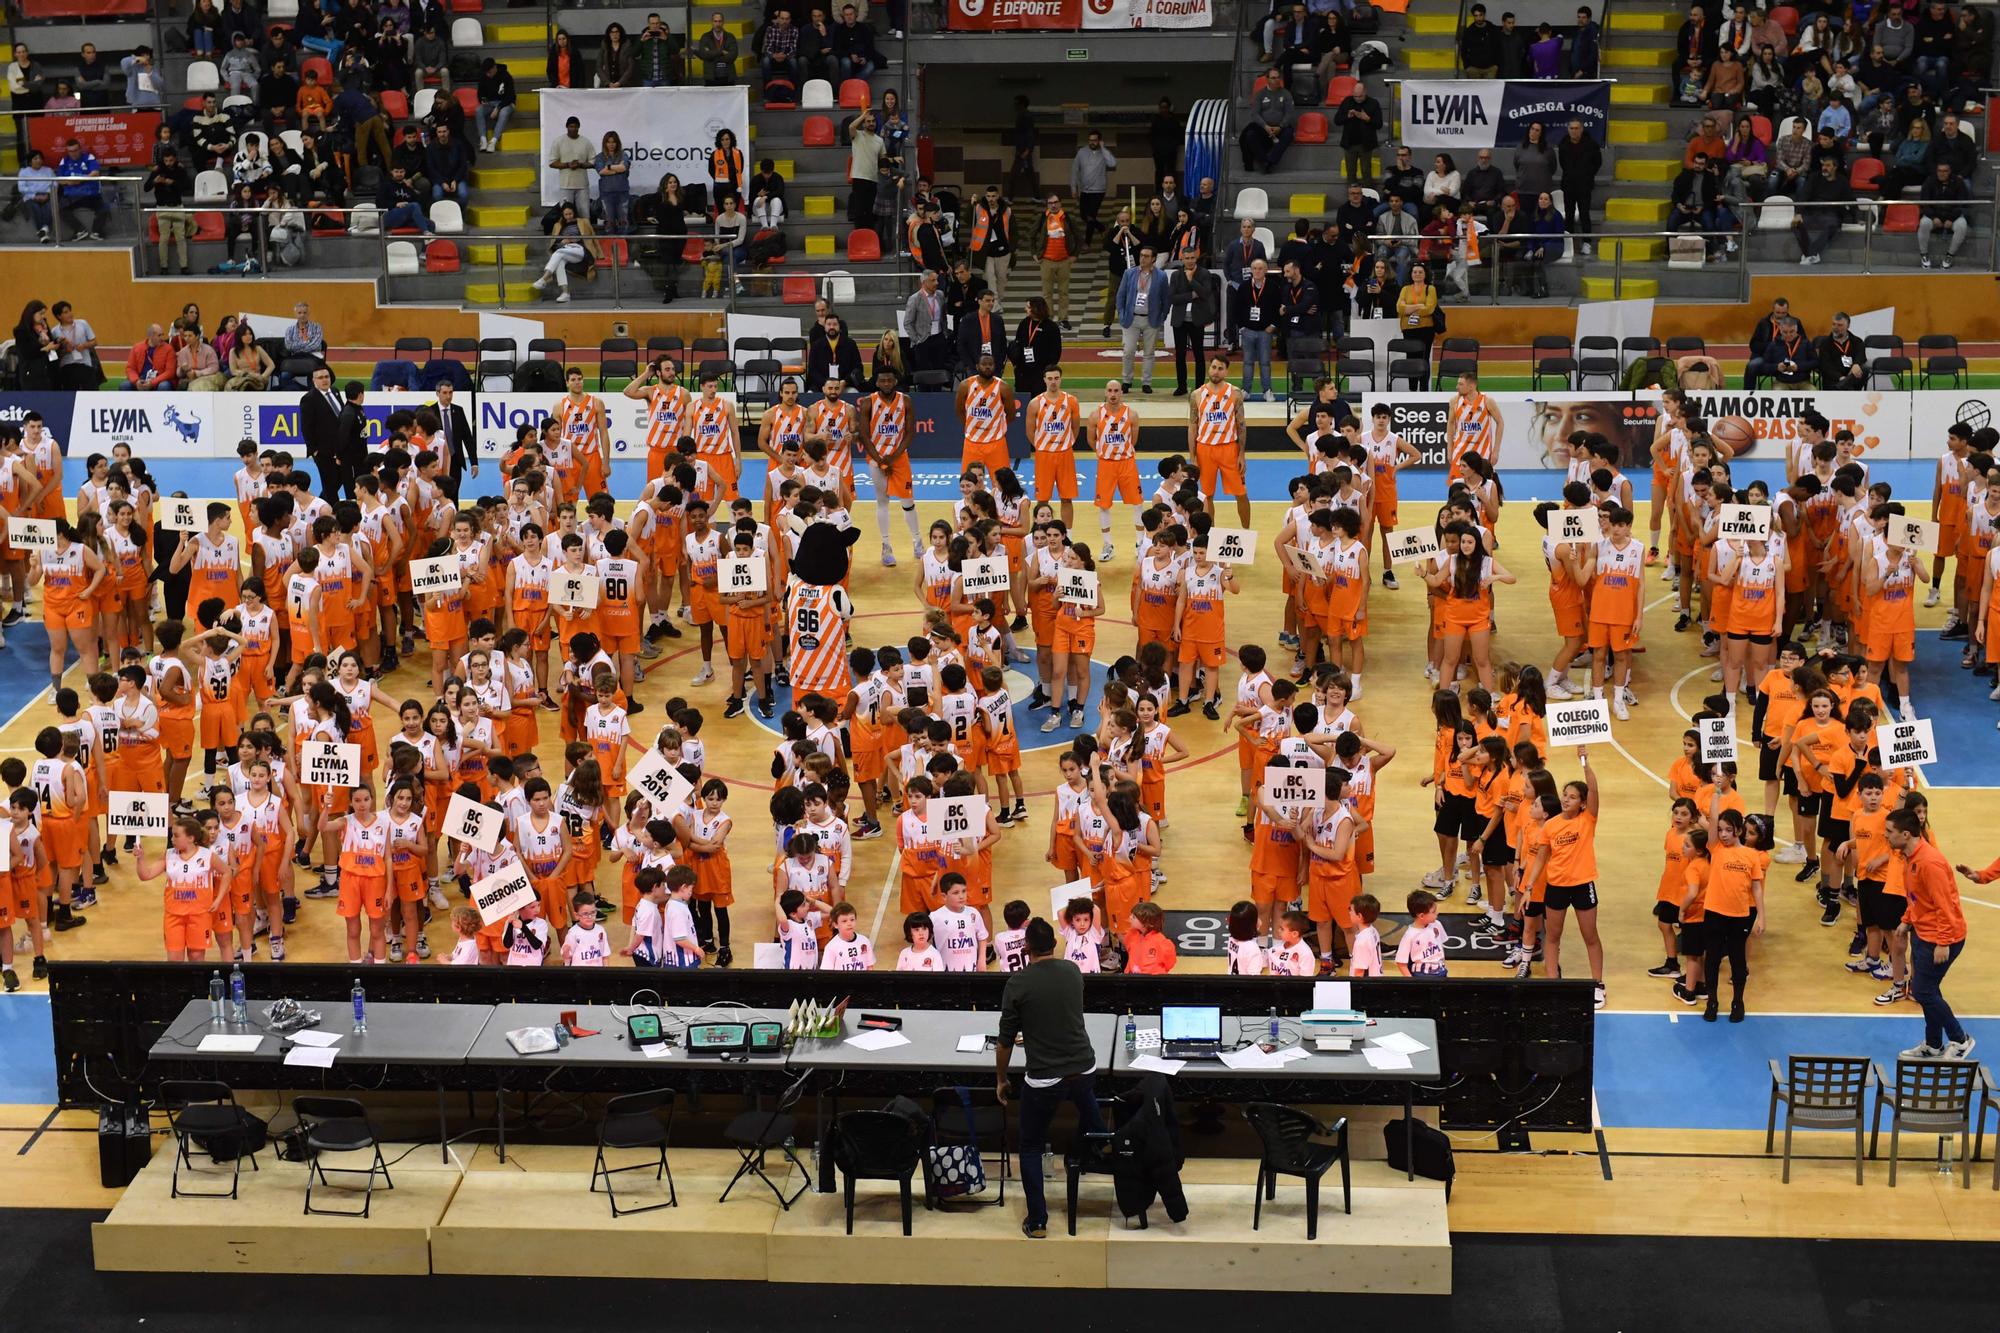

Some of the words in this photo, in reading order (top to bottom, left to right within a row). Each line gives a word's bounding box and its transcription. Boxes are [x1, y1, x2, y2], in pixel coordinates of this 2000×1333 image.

[1004, 1, 1062, 16] DEPORTE
[1411, 94, 1488, 126] LEYMA
[1508, 101, 1566, 119] GALEGA
[1569, 103, 1604, 119] 100%
[1436, 127, 1465, 136] NATURA
[656, 411, 678, 422] LEYMA
[971, 407, 993, 418] LEYMA
[1205, 411, 1228, 422] LEYMA
[1394, 407, 1431, 423] See
[1436, 410, 1448, 423] a
[91, 408, 152, 433] LEYMA
[1623, 417, 1655, 426] Securitas
[568, 423, 590, 434] LEYMA
[699, 424, 721, 435] LEYMA
[878, 424, 899, 434] LEYMA
[1043, 421, 1066, 432] LEYMA
[1460, 421, 1482, 432] LEYMA
[111, 434, 134, 442] NATURA
[1104, 433, 1126, 444] LEYMA
[177, 504, 191, 514] BC
[175, 515, 194, 526] U15
[1566, 515, 1579, 526] BC
[1738, 511, 1752, 522] BC
[27, 524, 38, 533] BC
[1563, 526, 1584, 537] U16
[1722, 522, 1756, 533] LEYMA
[1759, 523, 1765, 534] C
[1906, 523, 1920, 533] BC
[11, 534, 38, 544] LEYMA
[39, 535, 55, 545] U15
[1226, 535, 1239, 546] BC
[1406, 535, 1417, 545] BC
[1909, 534, 1916, 544] C
[1218, 546, 1244, 558] 2010
[1391, 547, 1419, 558] LEYMA
[1419, 543, 1437, 554] U16
[429, 564, 440, 574] BC
[735, 564, 748, 574] BC
[939, 566, 946, 574] 14
[980, 564, 991, 574] BC
[1752, 568, 1760, 576] 27
[413, 575, 441, 587] LEYMA
[442, 573, 459, 584] U14
[567, 579, 581, 590] BC
[731, 575, 752, 586] U13
[964, 575, 991, 587] LEYMA
[991, 572, 1008, 584] U13
[1072, 575, 1083, 586] BC
[1603, 575, 1628, 586] LEYMA
[321, 580, 344, 592] LEYMA
[605, 578, 628, 600] 80
[1062, 585, 1088, 599] LEYMA
[1144, 594, 1168, 605] LEYMA
[294, 596, 302, 619] 7
[797, 608, 819, 632] 96
[1556, 708, 1600, 723] COLEGIO
[955, 716, 967, 741] 2
[999, 712, 1008, 736] 7
[1551, 720, 1609, 737] MONTESPIÑO
[1711, 720, 1725, 732] CEIP
[1894, 726, 1916, 739] CEIP
[1708, 735, 1730, 746] CURROS
[1893, 737, 1922, 753] MARÍA
[323, 744, 338, 755] BC
[1888, 750, 1929, 765] BARBEITO
[311, 757, 349, 771] LEYMA
[310, 771, 349, 785] U11-12
[654, 768, 673, 787] BC
[1287, 775, 1303, 787] BC
[640, 774, 669, 802] 2014
[35, 782, 52, 810] 14
[1272, 787, 1316, 801] U11-12
[132, 801, 146, 813] BC
[948, 803, 964, 817] BC
[110, 813, 144, 828] LEYMA
[146, 817, 166, 829] U11
[466, 808, 483, 825] BC
[943, 819, 968, 832] U10
[1093, 819, 1102, 828] 23
[361, 830, 369, 840] 21
[462, 822, 479, 838] U9
[820, 830, 829, 839] 76
[537, 835, 546, 845] 78
[354, 854, 376, 865] LEYMA
[174, 889, 197, 901] LEYMA
[477, 875, 528, 911] BIBERONES
[947, 938, 974, 949] LEYMA
[848, 947, 858, 957] 23
[1279, 952, 1289, 961] 23
